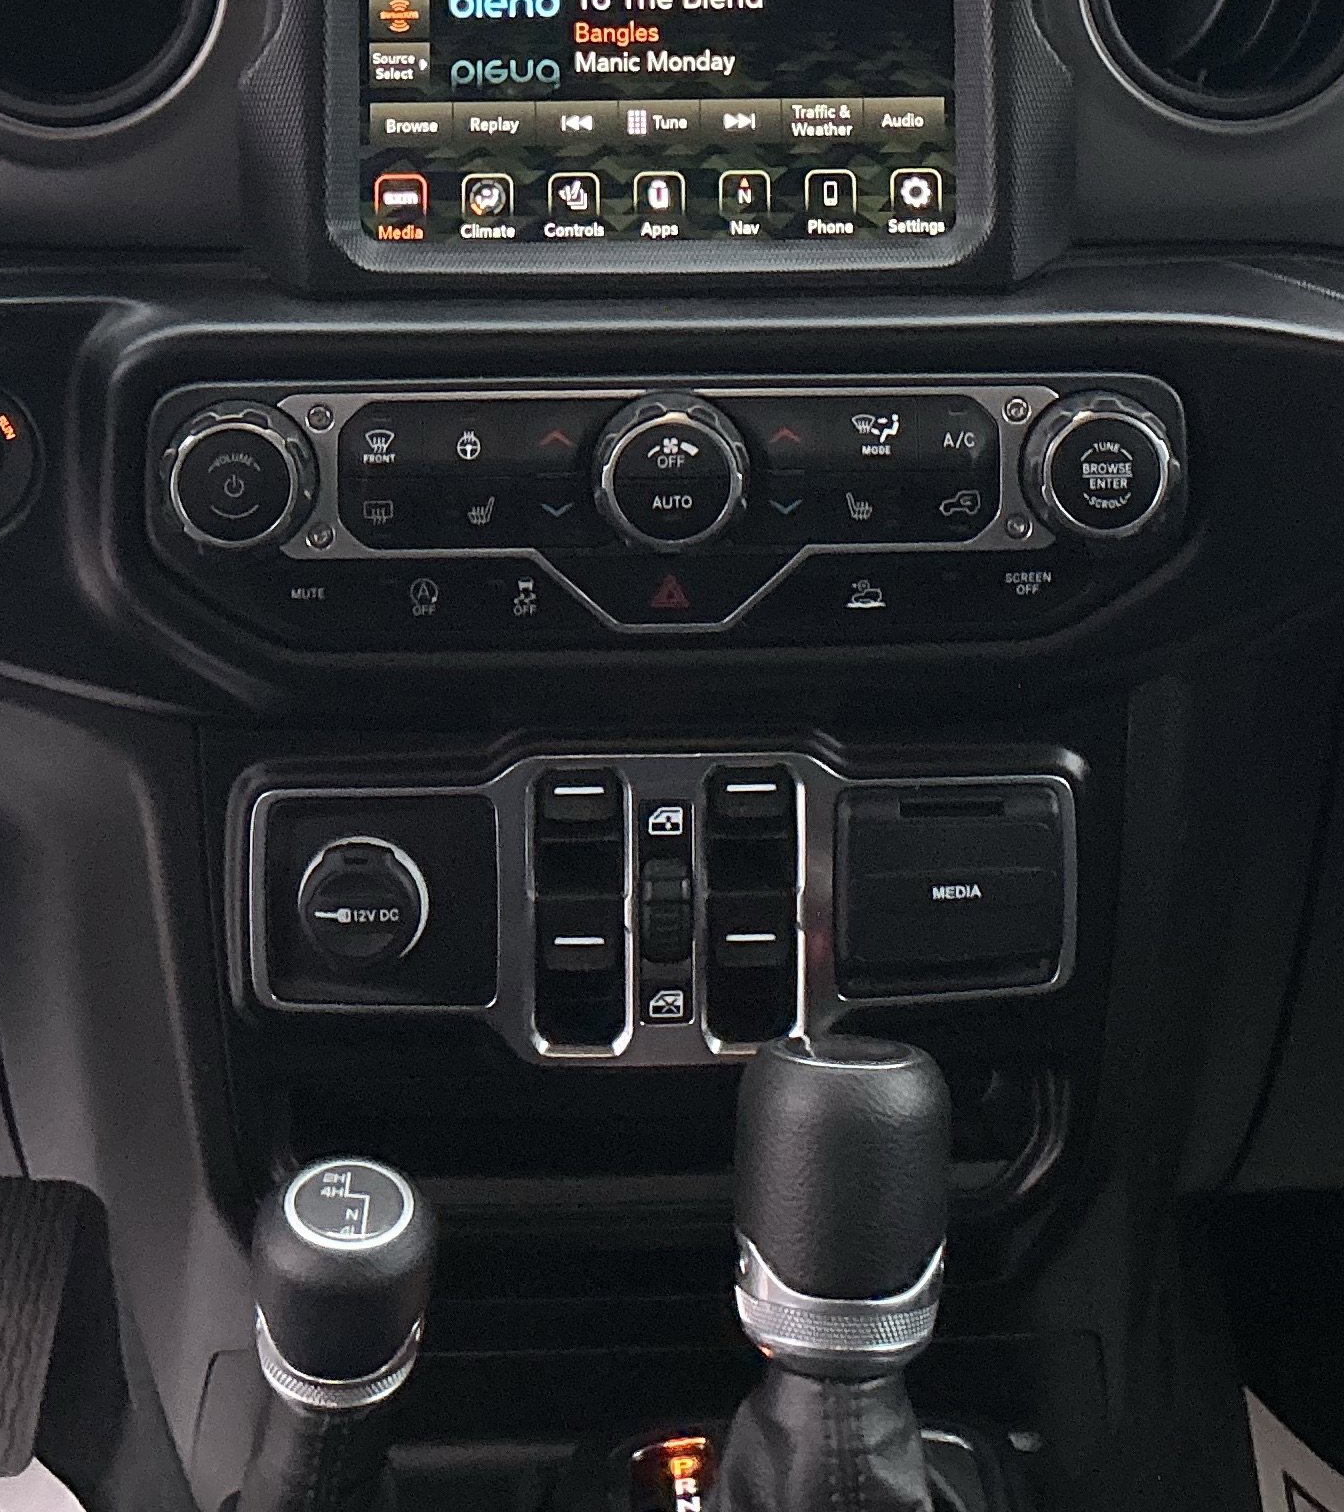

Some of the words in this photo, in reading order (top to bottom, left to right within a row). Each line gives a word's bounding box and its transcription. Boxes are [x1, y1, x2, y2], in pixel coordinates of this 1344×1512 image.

[574, 23, 659, 46] Bangles
[373, 53, 415, 65] Source
[575, 53, 639, 74] Manic
[647, 51, 736, 76] Monday
[375, 68, 413, 80] Select
[792, 105, 833, 120] Traffic
[839, 105, 851, 119] &
[385, 119, 438, 133] Browse
[470, 117, 519, 135] Replay
[653, 115, 687, 130] Tune
[881, 113, 924, 129] Audio
[791, 121, 853, 137] Weather
[378, 224, 424, 240] Media
[460, 223, 516, 239] Climate
[544, 221, 605, 238] Controls
[641, 222, 679, 241] Apps
[730, 221, 760, 236] Nav
[807, 220, 854, 236] Phone
[888, 218, 945, 238] Settings
[943, 432, 975, 449] A/C
[1093, 441, 1121, 454] TUNE
[862, 445, 891, 455] MODE
[213, 453, 254, 467] VOLUME
[363, 454, 396, 464] FRONT
[658, 454, 685, 469] OFF
[1083, 463, 1132, 474] BROWSE
[1090, 478, 1128, 490] ENTER
[653, 495, 693, 510] AUTO
[1089, 496, 1128, 509] SCROLL
[1006, 572, 1052, 583] SCREEN
[291, 588, 325, 599] MUTE
[1016, 584, 1040, 595] OFF
[412, 604, 435, 616] OFF
[513, 604, 536, 616] OFF
[932, 884, 981, 900] MEDIA
[353, 909, 376, 922] 12V
[380, 909, 399, 921] DC
[321, 1186, 344, 1197] 4H
[346, 1208, 358, 1220] N
[673, 1458, 694, 1476] P
[675, 1478, 697, 1495] R
